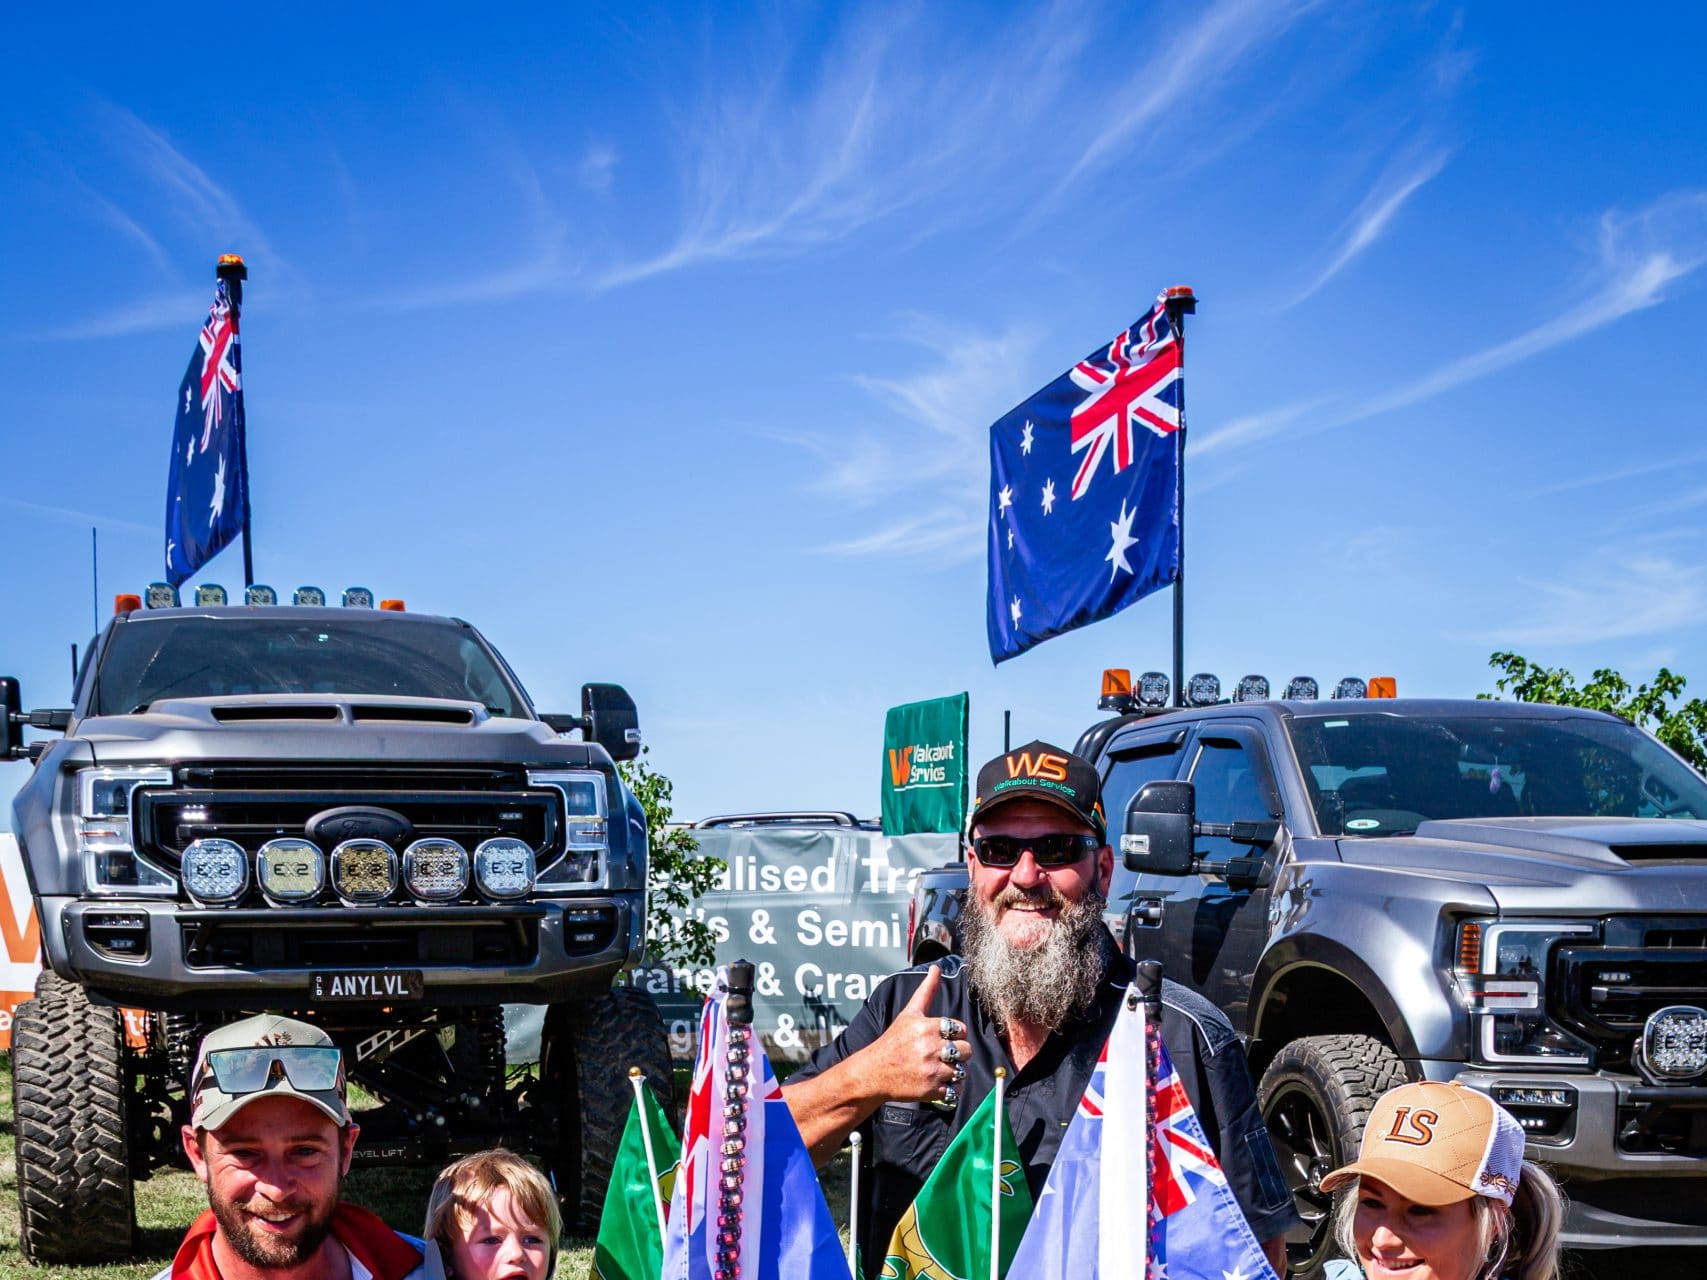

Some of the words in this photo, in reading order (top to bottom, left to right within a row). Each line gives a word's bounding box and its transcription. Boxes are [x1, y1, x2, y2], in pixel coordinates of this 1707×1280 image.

[1006, 752, 1069, 782] WS
[993, 777, 1038, 793] Walkabout
[1039, 778, 1077, 798] Services
[274, 862, 309, 877] EX2
[491, 861, 523, 874] EX2
[749, 909, 777, 945] &
[797, 910, 900, 948] Semi
[330, 975, 409, 996] ANYLVL
[756, 962, 784, 996] &
[773, 1013, 804, 1048] &
[1385, 1106, 1440, 1147] LS
